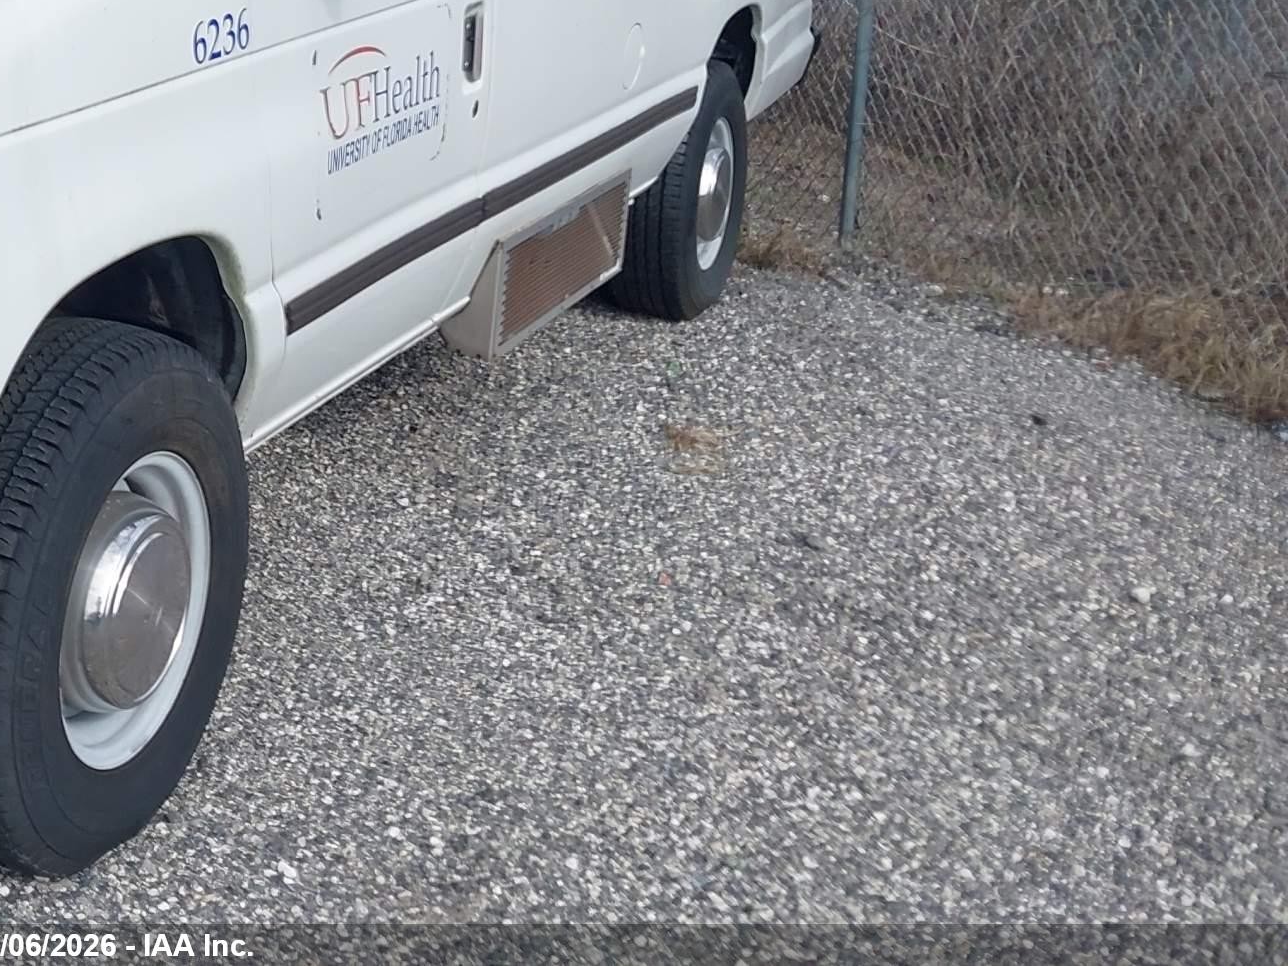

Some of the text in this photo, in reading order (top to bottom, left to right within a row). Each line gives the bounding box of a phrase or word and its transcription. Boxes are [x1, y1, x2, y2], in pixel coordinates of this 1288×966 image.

[193, 8, 250, 64] 6236
[319, 50, 440, 140] UFHealth
[327, 105, 441, 175] UNIVERSITY OF FLORIDA HEALTH
